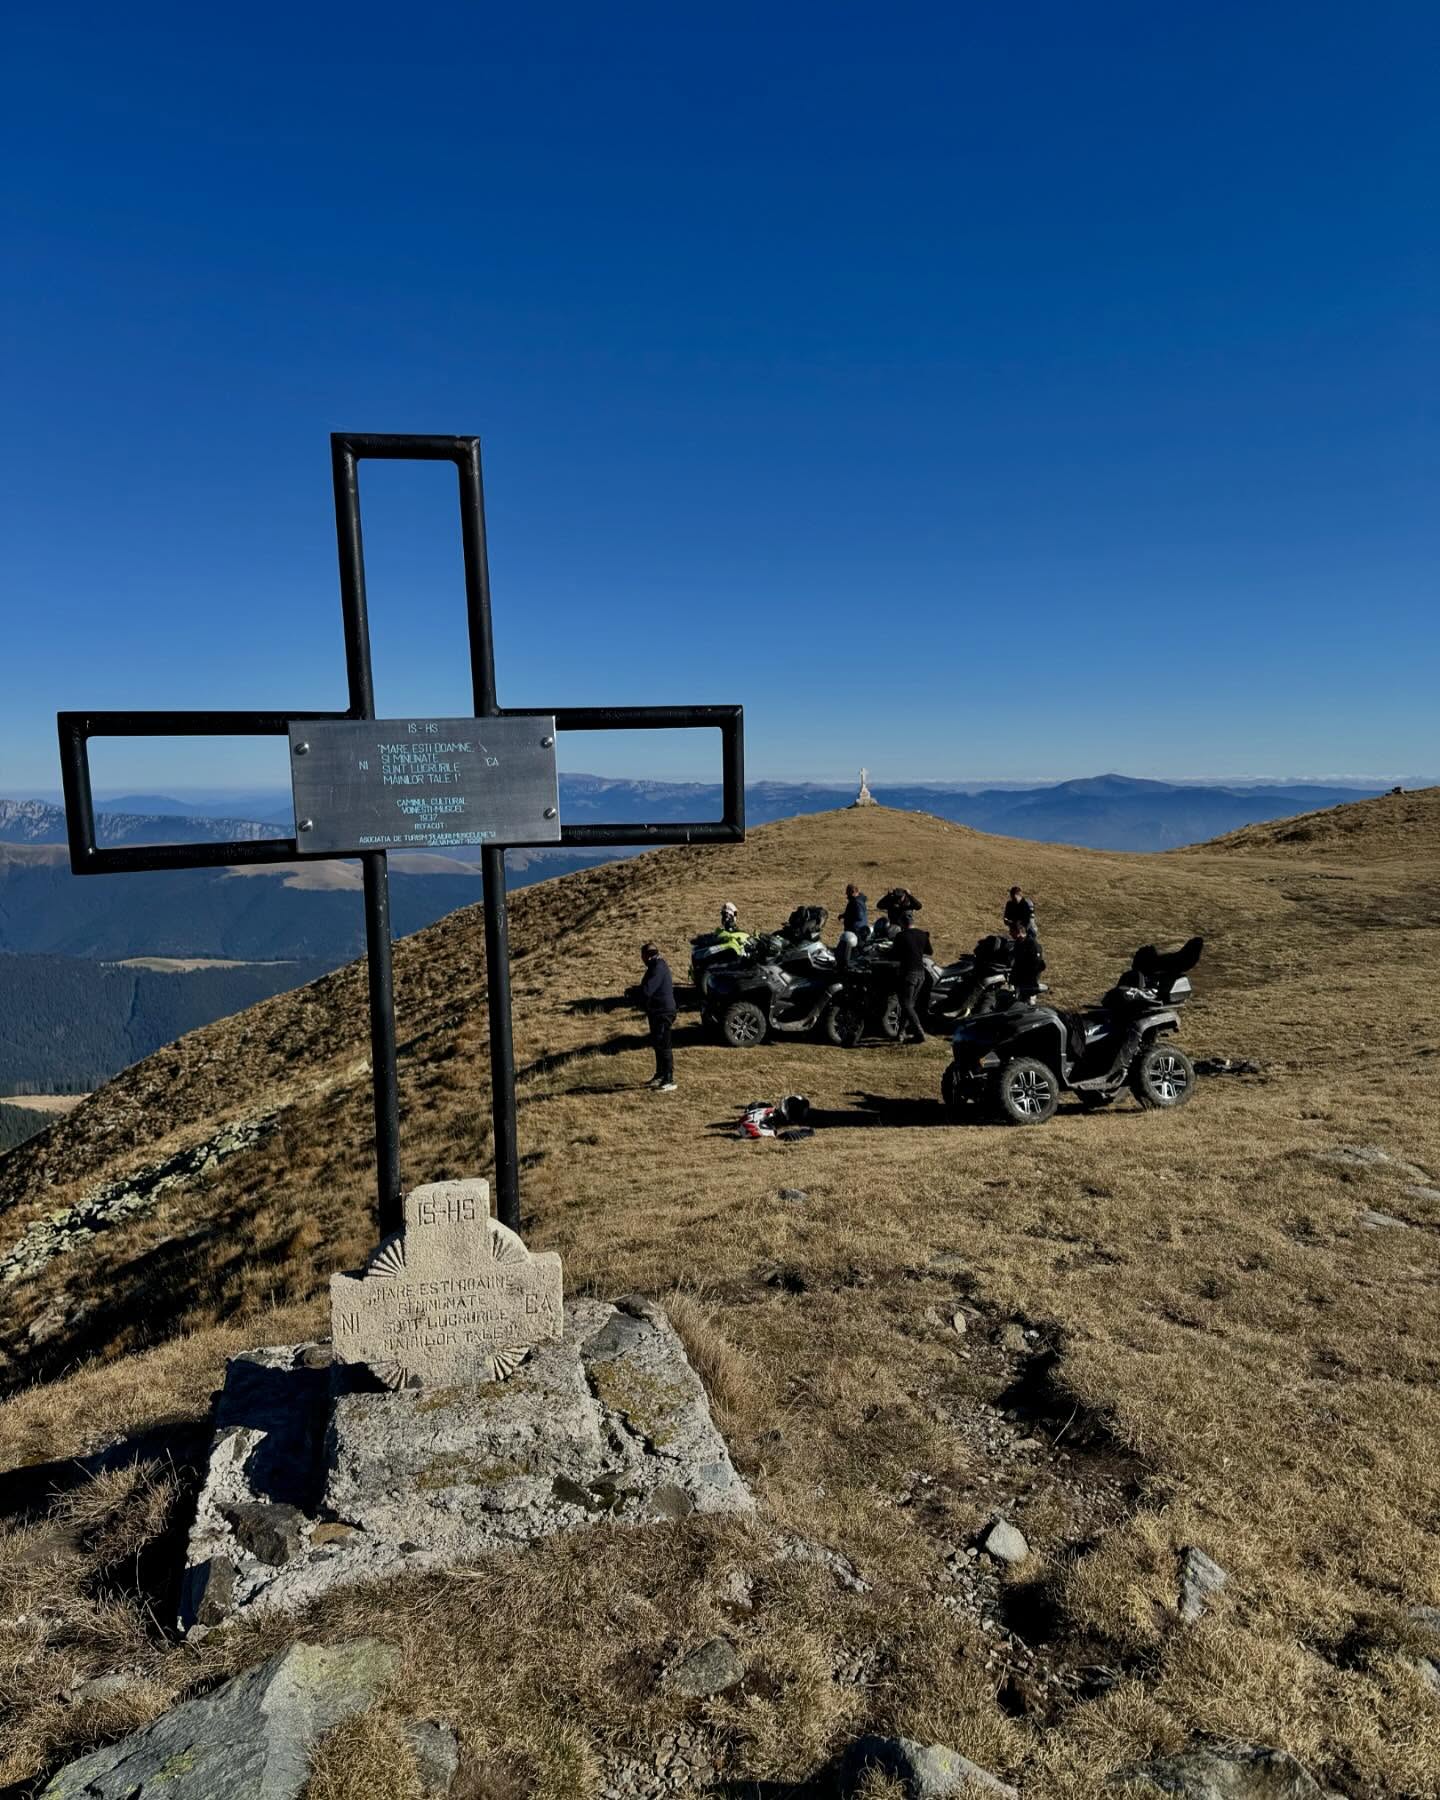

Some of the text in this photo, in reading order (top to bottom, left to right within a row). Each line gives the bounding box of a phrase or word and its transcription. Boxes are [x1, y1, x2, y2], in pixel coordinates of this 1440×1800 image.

[412, 743, 431, 753] ESTI
[359, 760, 369, 770] NI
[486, 757, 499, 767] CA
[382, 764, 405, 775] SUNT
[429, 774, 451, 784] TALE
[420, 1278, 453, 1298] ESTI
[341, 1311, 360, 1335] NI
